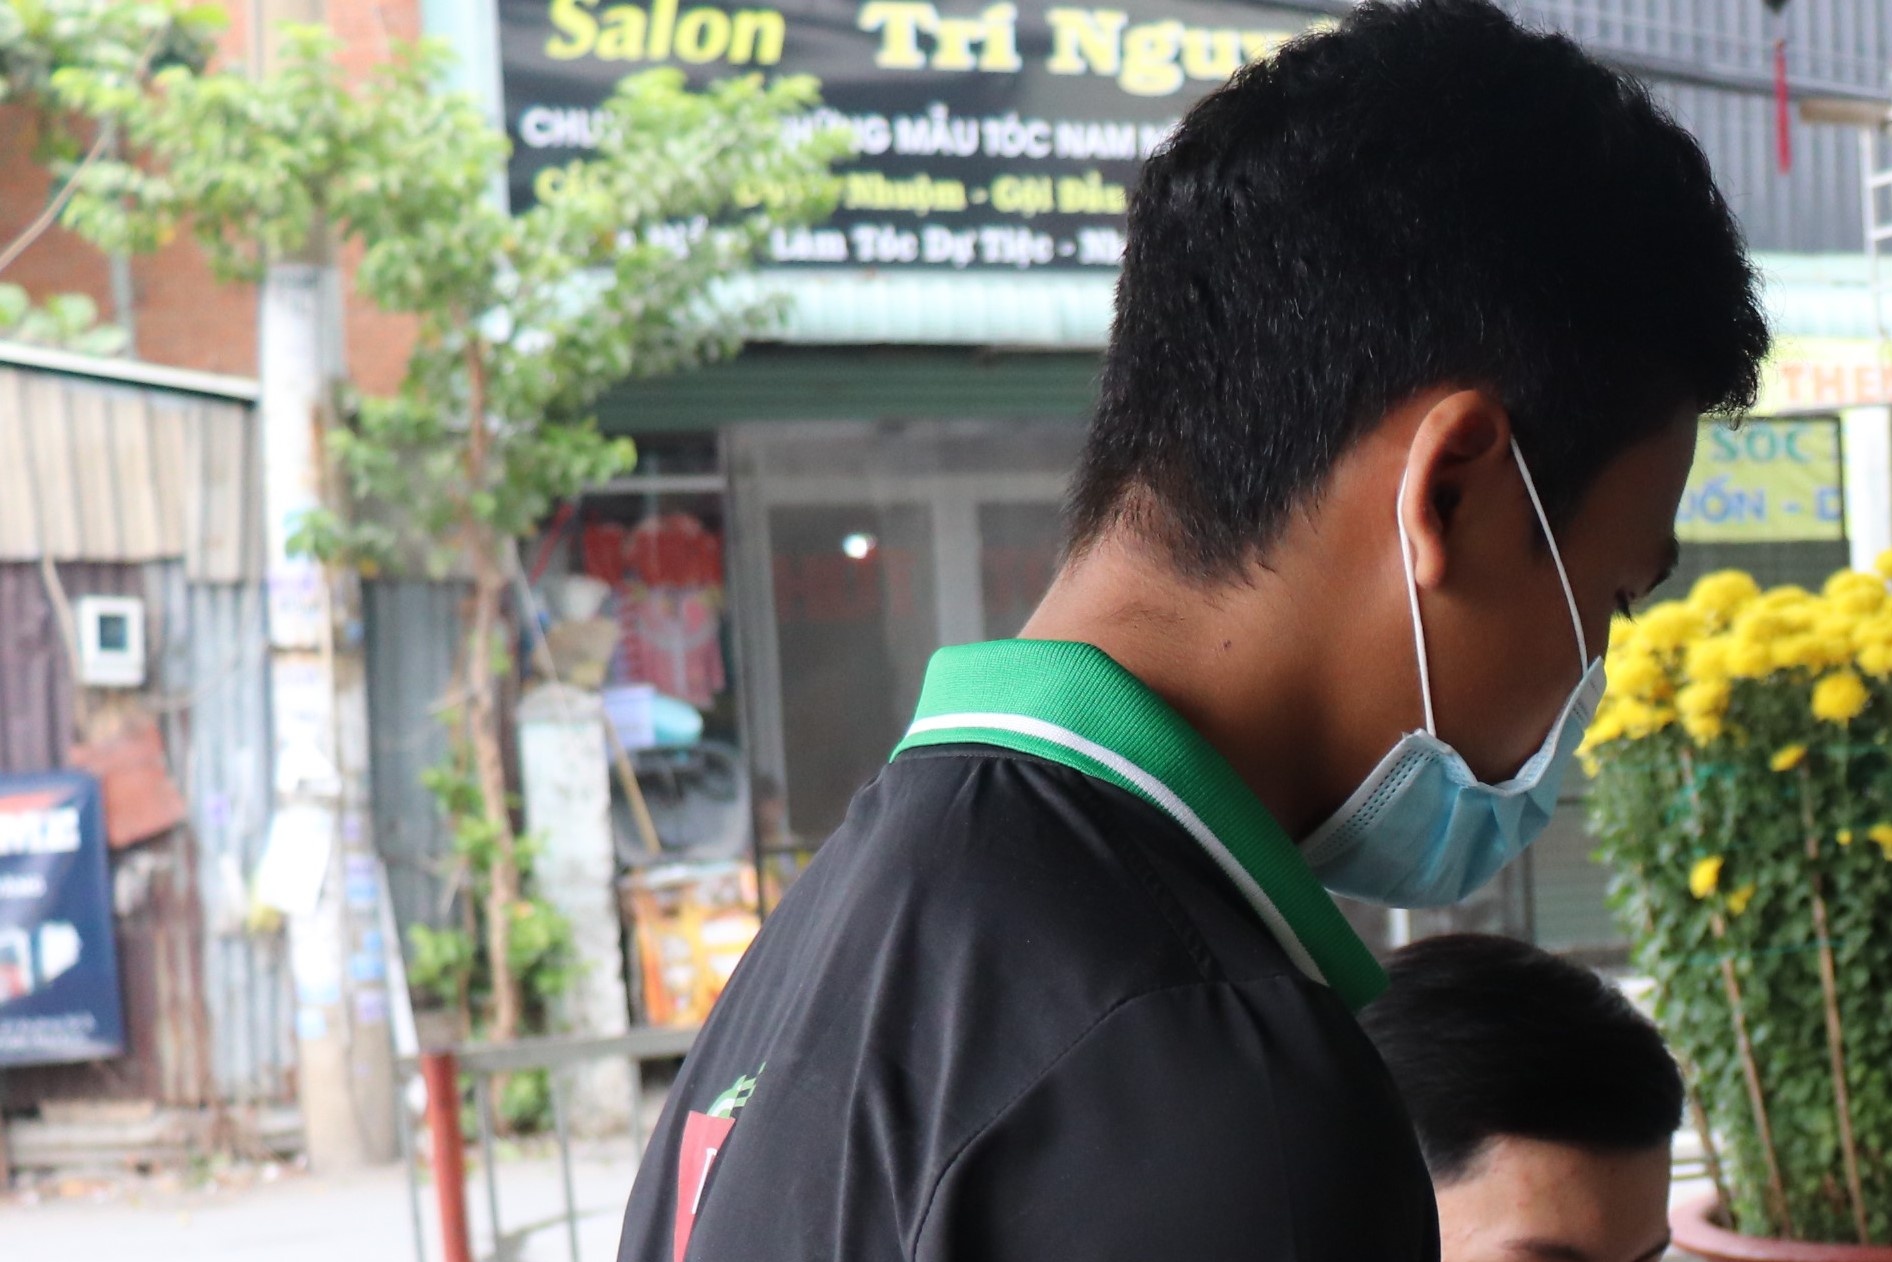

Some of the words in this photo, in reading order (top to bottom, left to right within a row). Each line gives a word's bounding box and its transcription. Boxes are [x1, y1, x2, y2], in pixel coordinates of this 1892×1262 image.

[545, 0, 786, 65] Salon
[1046, 8, 1342, 98] Ngu
[1055, 121, 1137, 160] NAM
